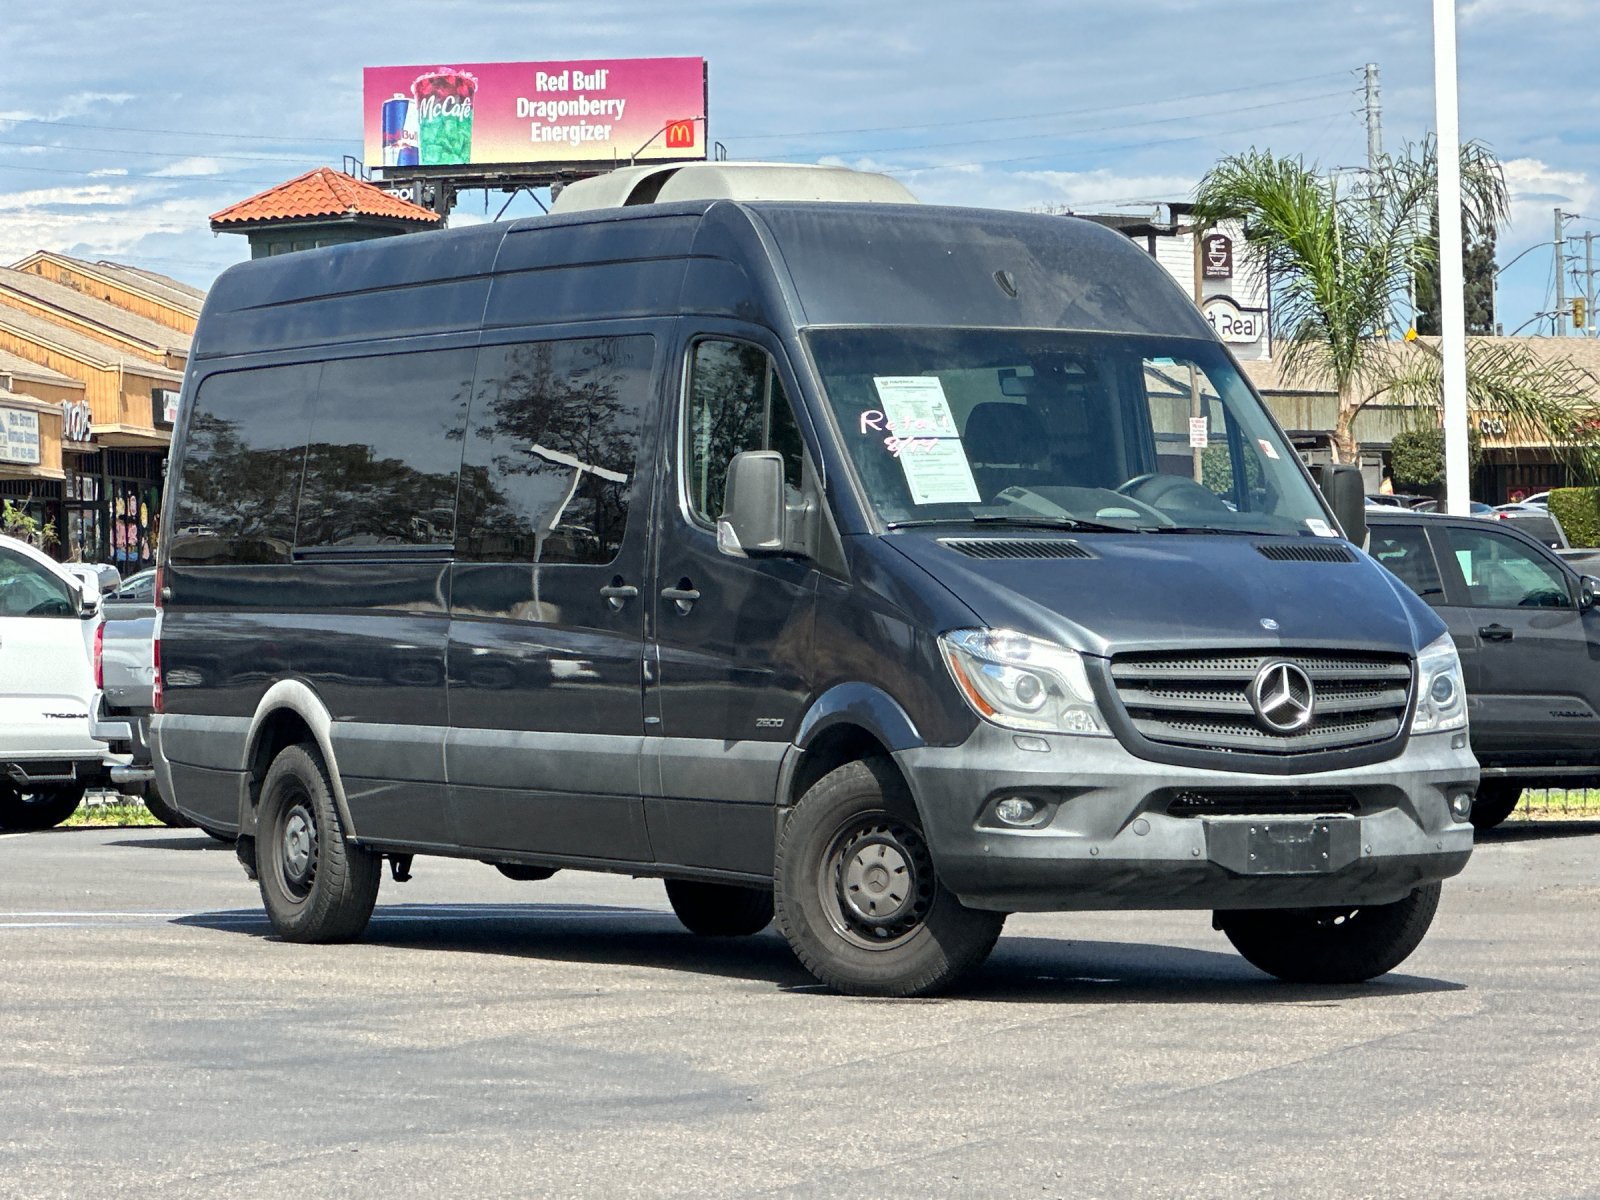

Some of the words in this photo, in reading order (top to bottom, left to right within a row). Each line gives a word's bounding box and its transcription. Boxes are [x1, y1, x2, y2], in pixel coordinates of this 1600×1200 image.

[535, 70, 569, 92] Red
[572, 69, 607, 91] Bull
[516, 95, 626, 122] Dragonberry
[531, 120, 611, 147] Energizer
[1222, 314, 1256, 336] Real
